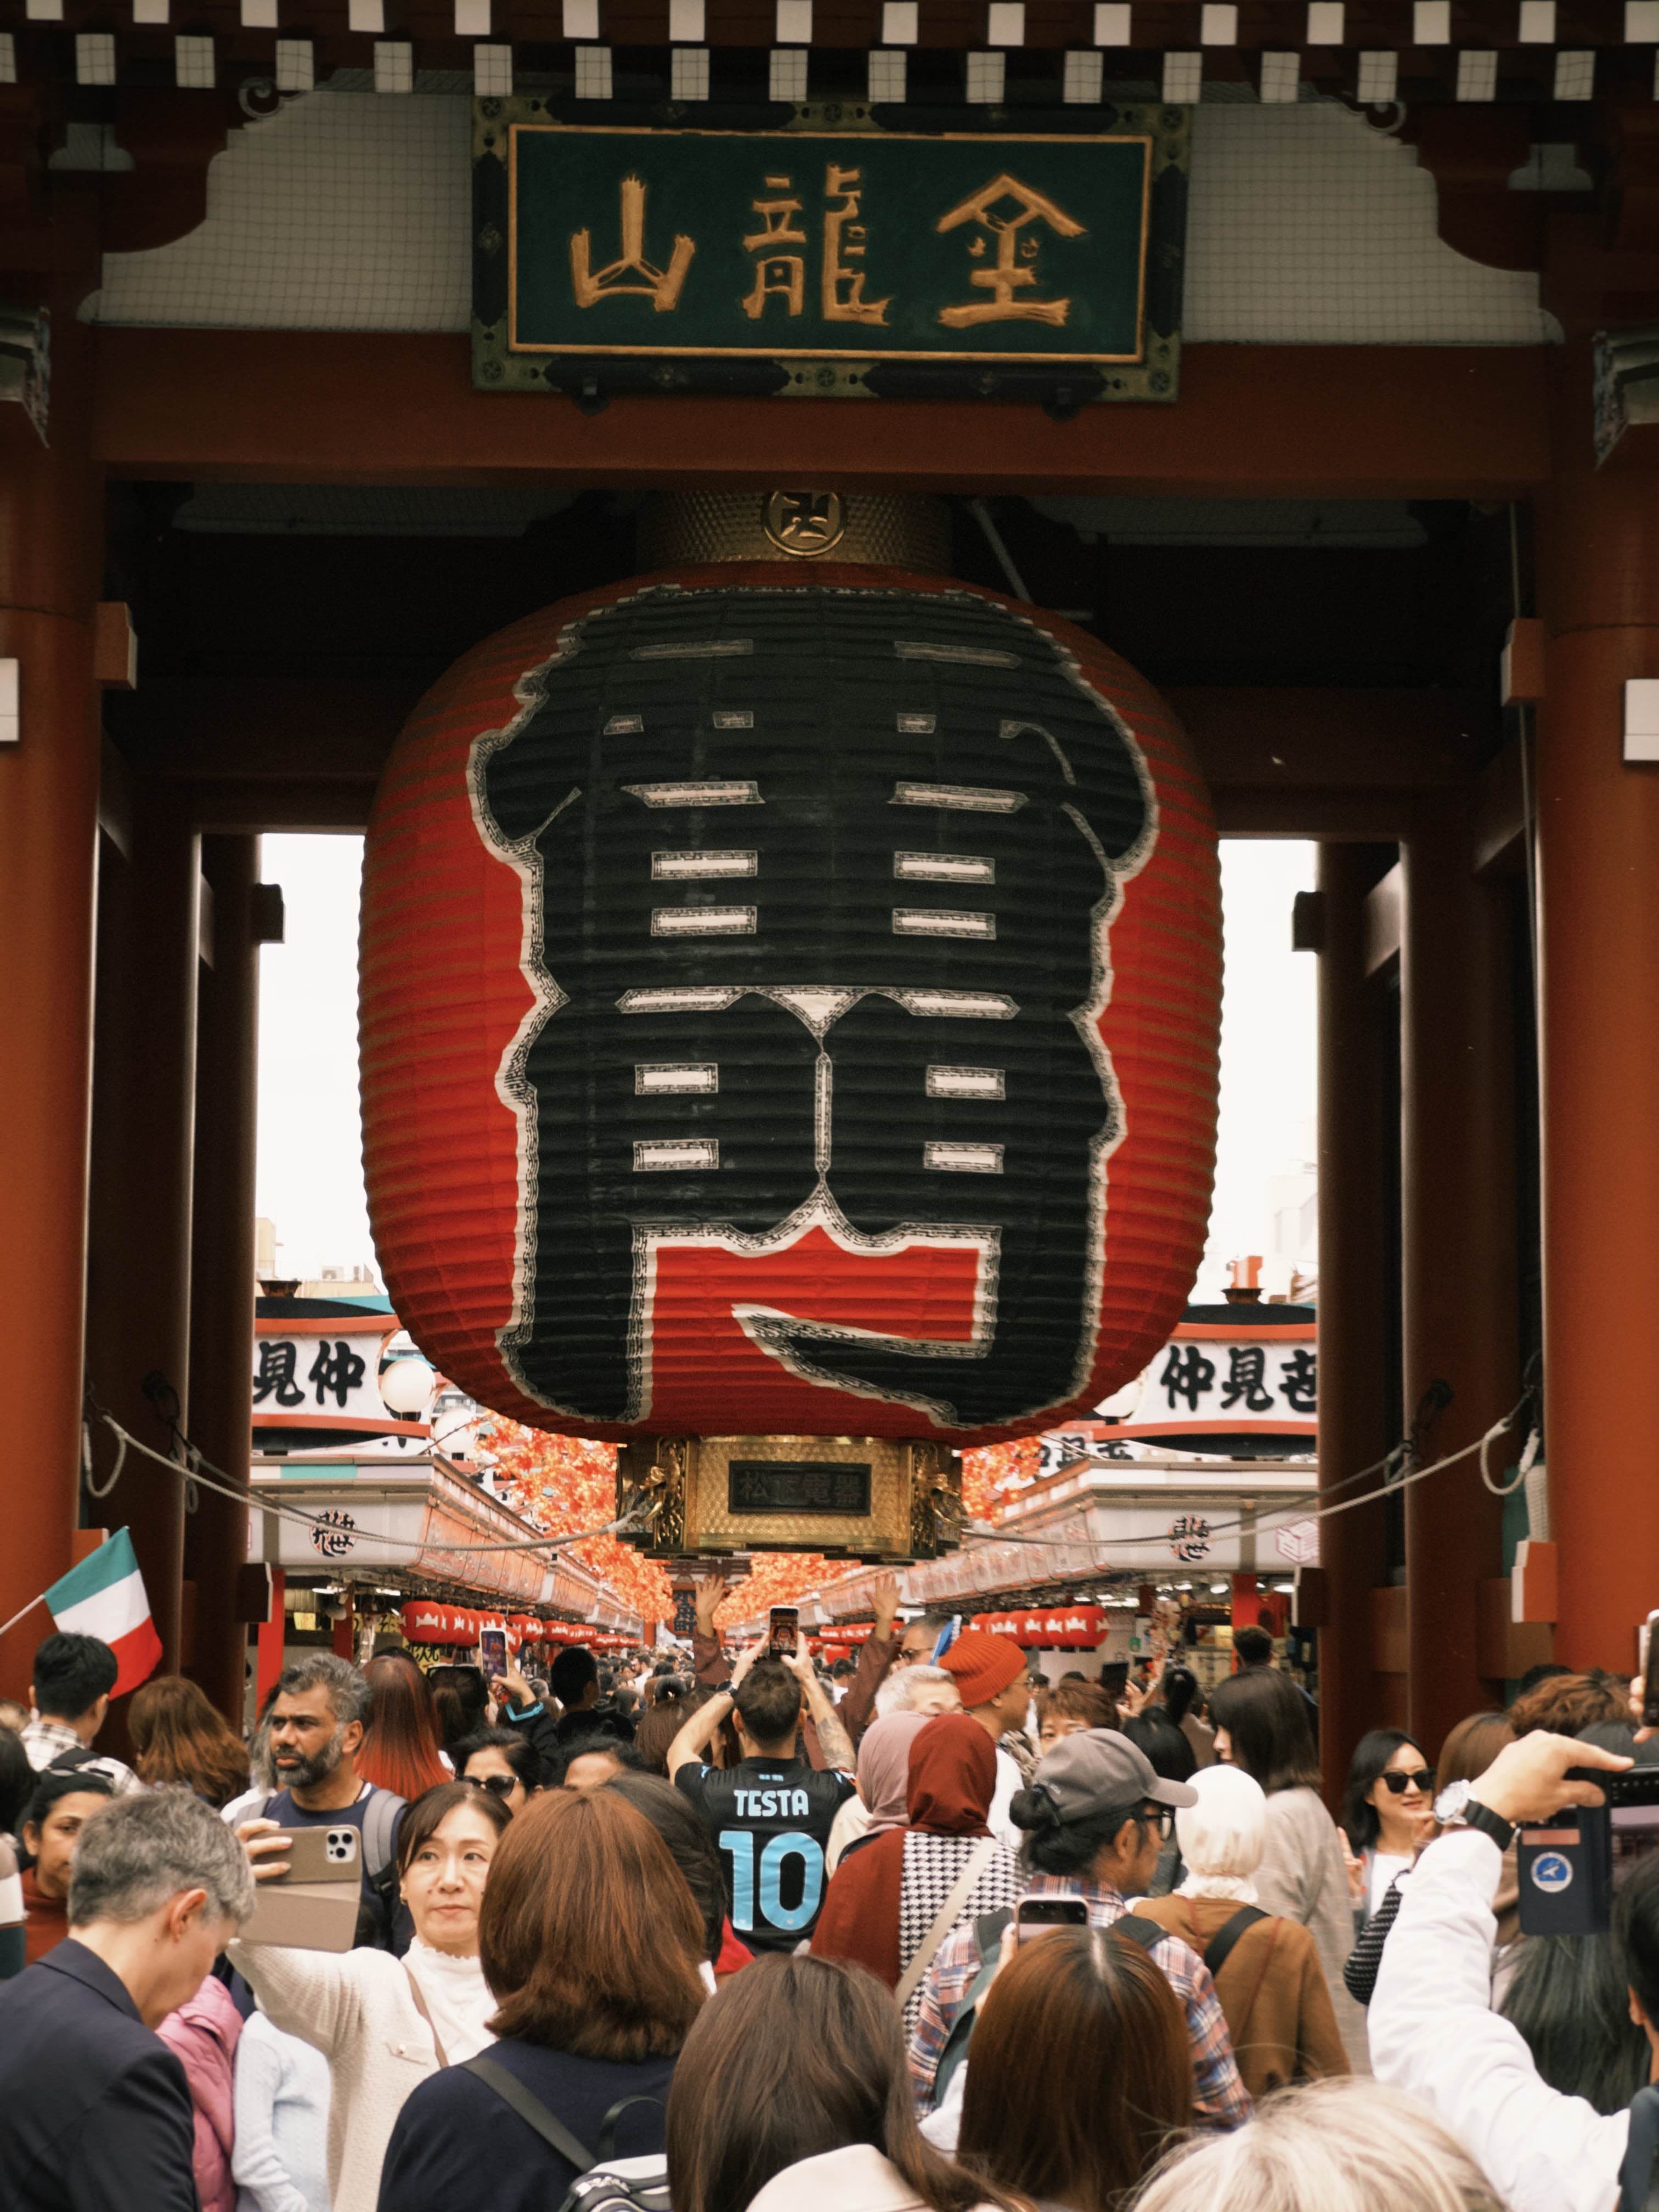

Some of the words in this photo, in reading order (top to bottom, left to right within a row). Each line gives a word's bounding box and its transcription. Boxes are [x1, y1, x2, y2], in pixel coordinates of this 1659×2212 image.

[465, 583, 1161, 1430] 雷門
[733, 1789, 809, 1817] TESTA
[719, 1830, 824, 1931] 10
